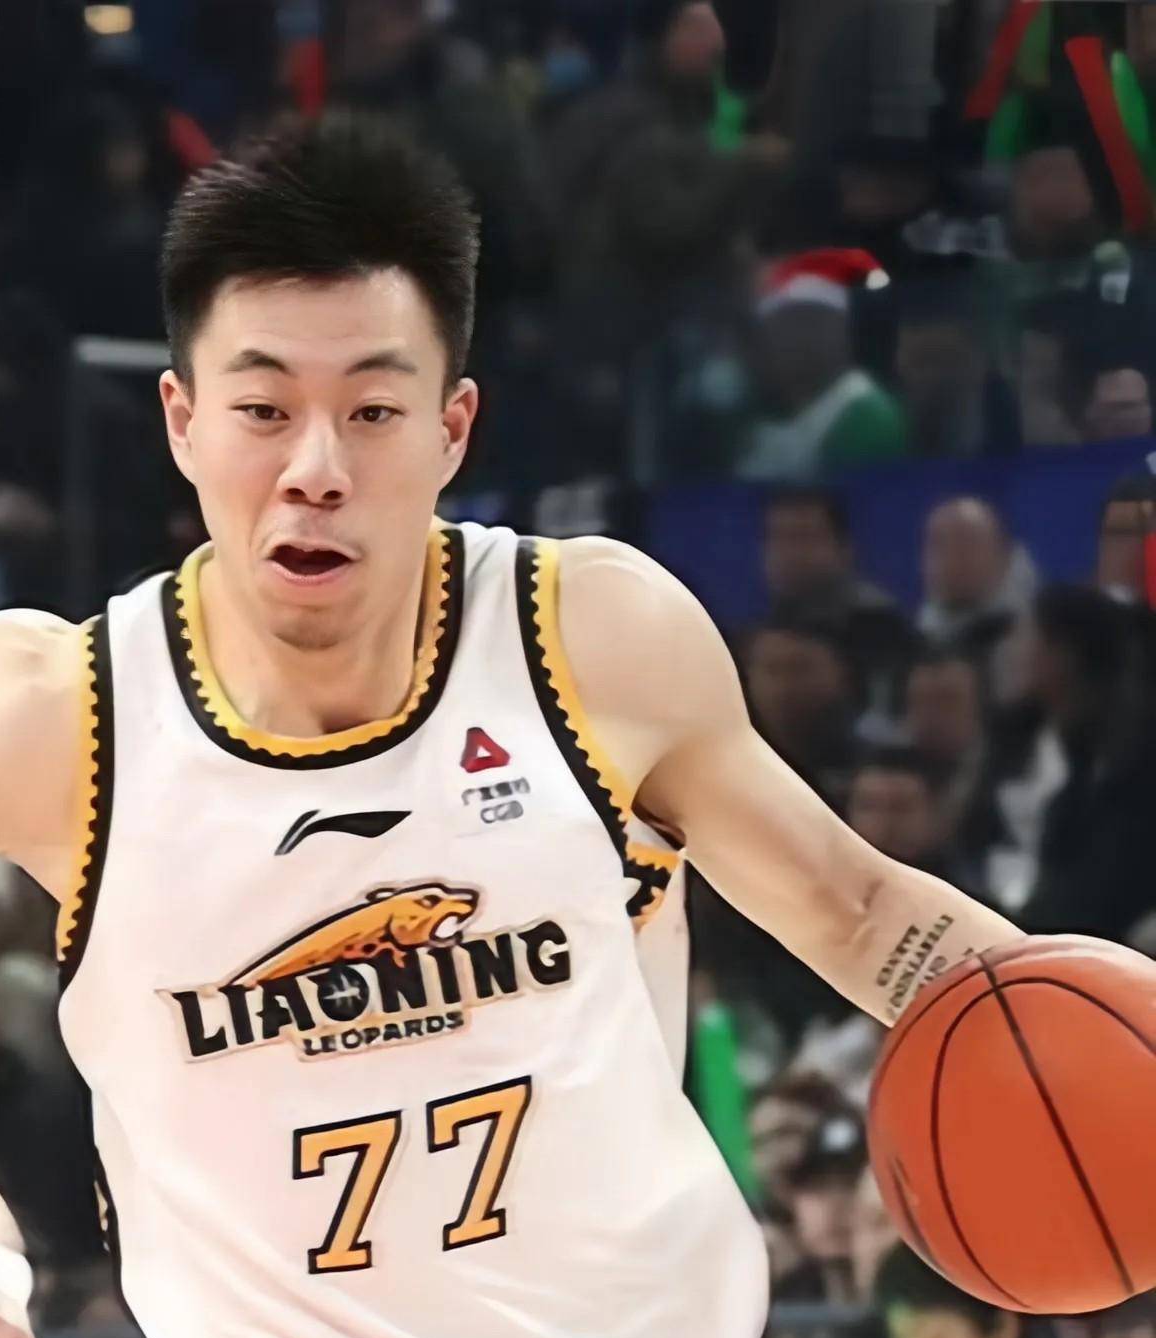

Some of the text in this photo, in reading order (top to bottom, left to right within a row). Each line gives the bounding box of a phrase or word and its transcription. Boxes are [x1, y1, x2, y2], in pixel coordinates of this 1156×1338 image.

[171, 920, 572, 1058] LIAONING
[303, 1011, 464, 1056] LEOPARDS
[292, 1075, 533, 1275] 77
